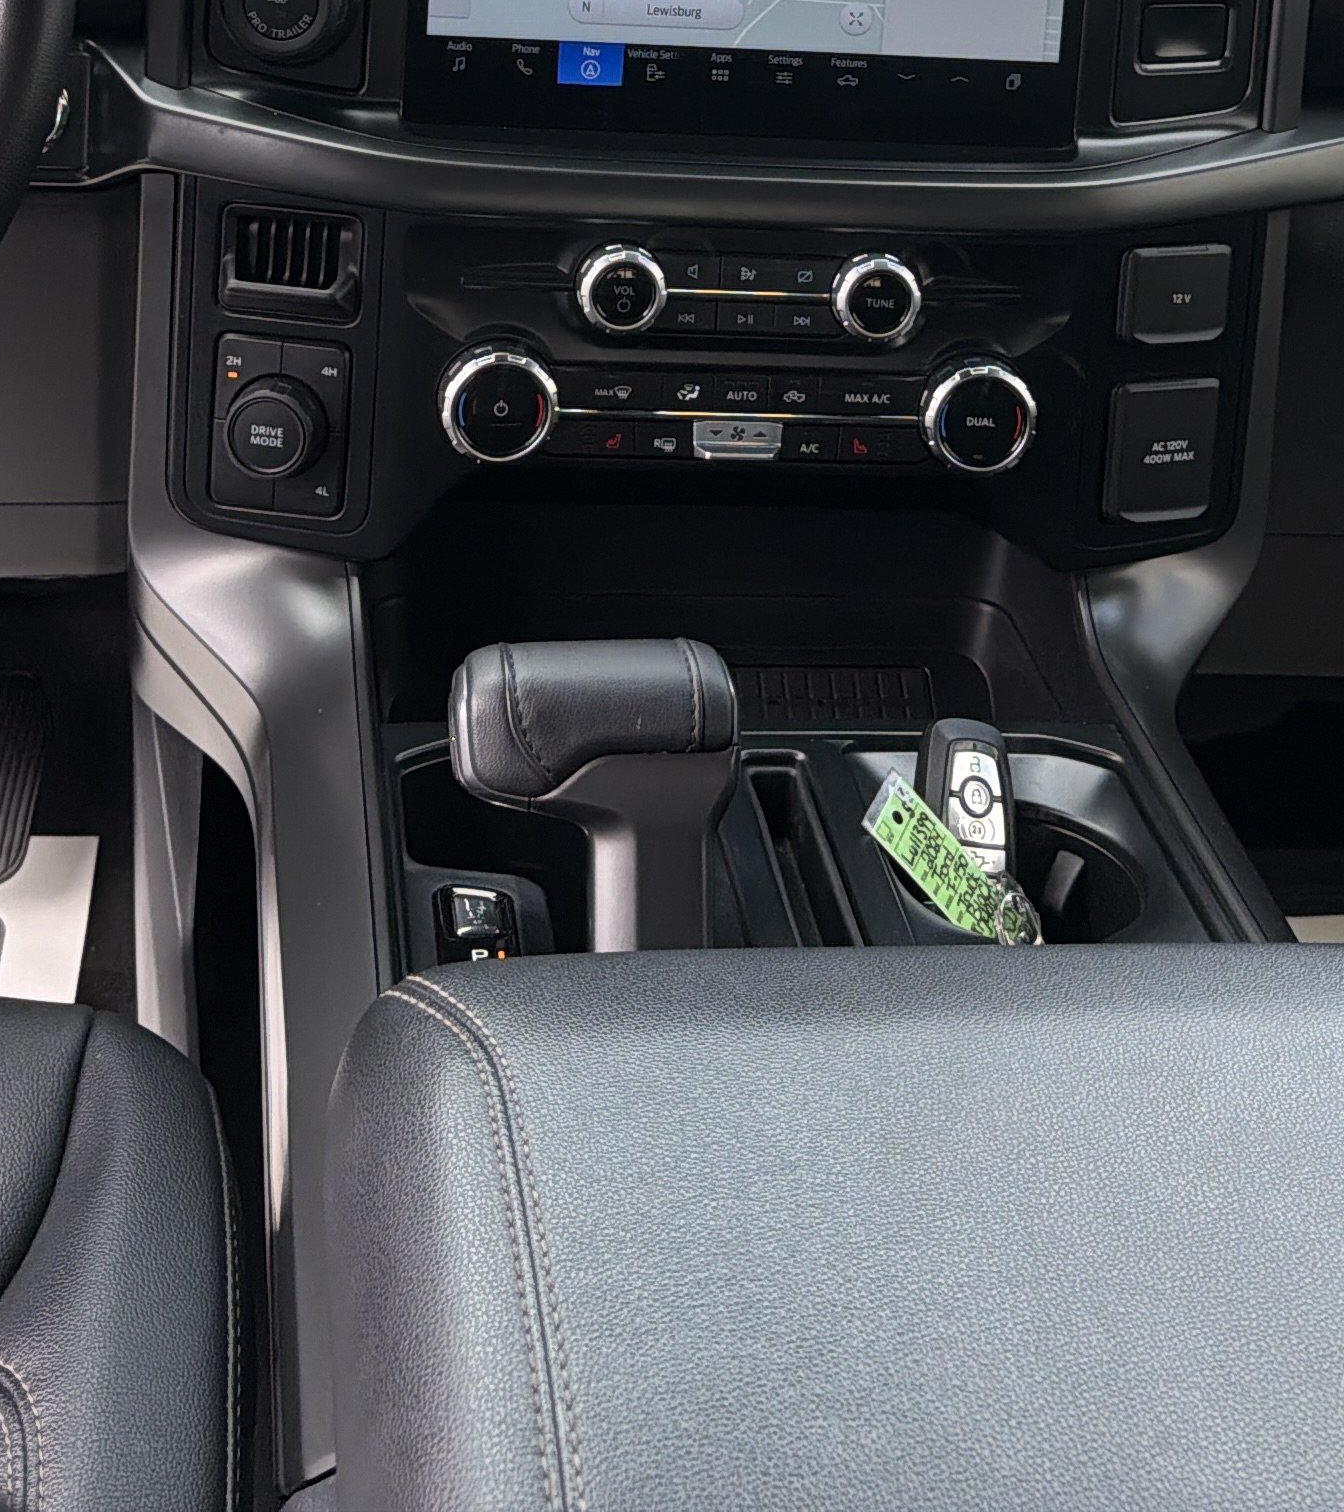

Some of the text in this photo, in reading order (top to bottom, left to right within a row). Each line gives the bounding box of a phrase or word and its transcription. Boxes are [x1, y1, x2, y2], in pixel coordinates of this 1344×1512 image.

[582, 1, 703, 20] N Lewisburg
[247, 11, 314, 39] PRO TRAILER
[446, 41, 473, 52] Audio
[511, 43, 540, 55] Phone
[582, 46, 601, 57] Nav
[627, 49, 658, 60] Vehicle
[710, 52, 733, 65] Apps
[768, 55, 804, 68] Settings
[830, 58, 868, 69] Features
[613, 284, 636, 297] VOL
[865, 297, 895, 310] TUNE
[225, 355, 242, 367] 2H
[320, 366, 338, 378] 4H
[594, 387, 614, 397] MAX
[726, 390, 758, 402] AUTO
[844, 392, 891, 405] MAX A/C
[966, 416, 996, 429] DUAL
[250, 424, 284, 438] DRIVE
[250, 435, 284, 448] MODE
[1151, 439, 1189, 453] AC 120V
[799, 442, 820, 455] A/C
[1143, 450, 1195, 465] 400W MAX
[314, 485, 330, 497] 4L
